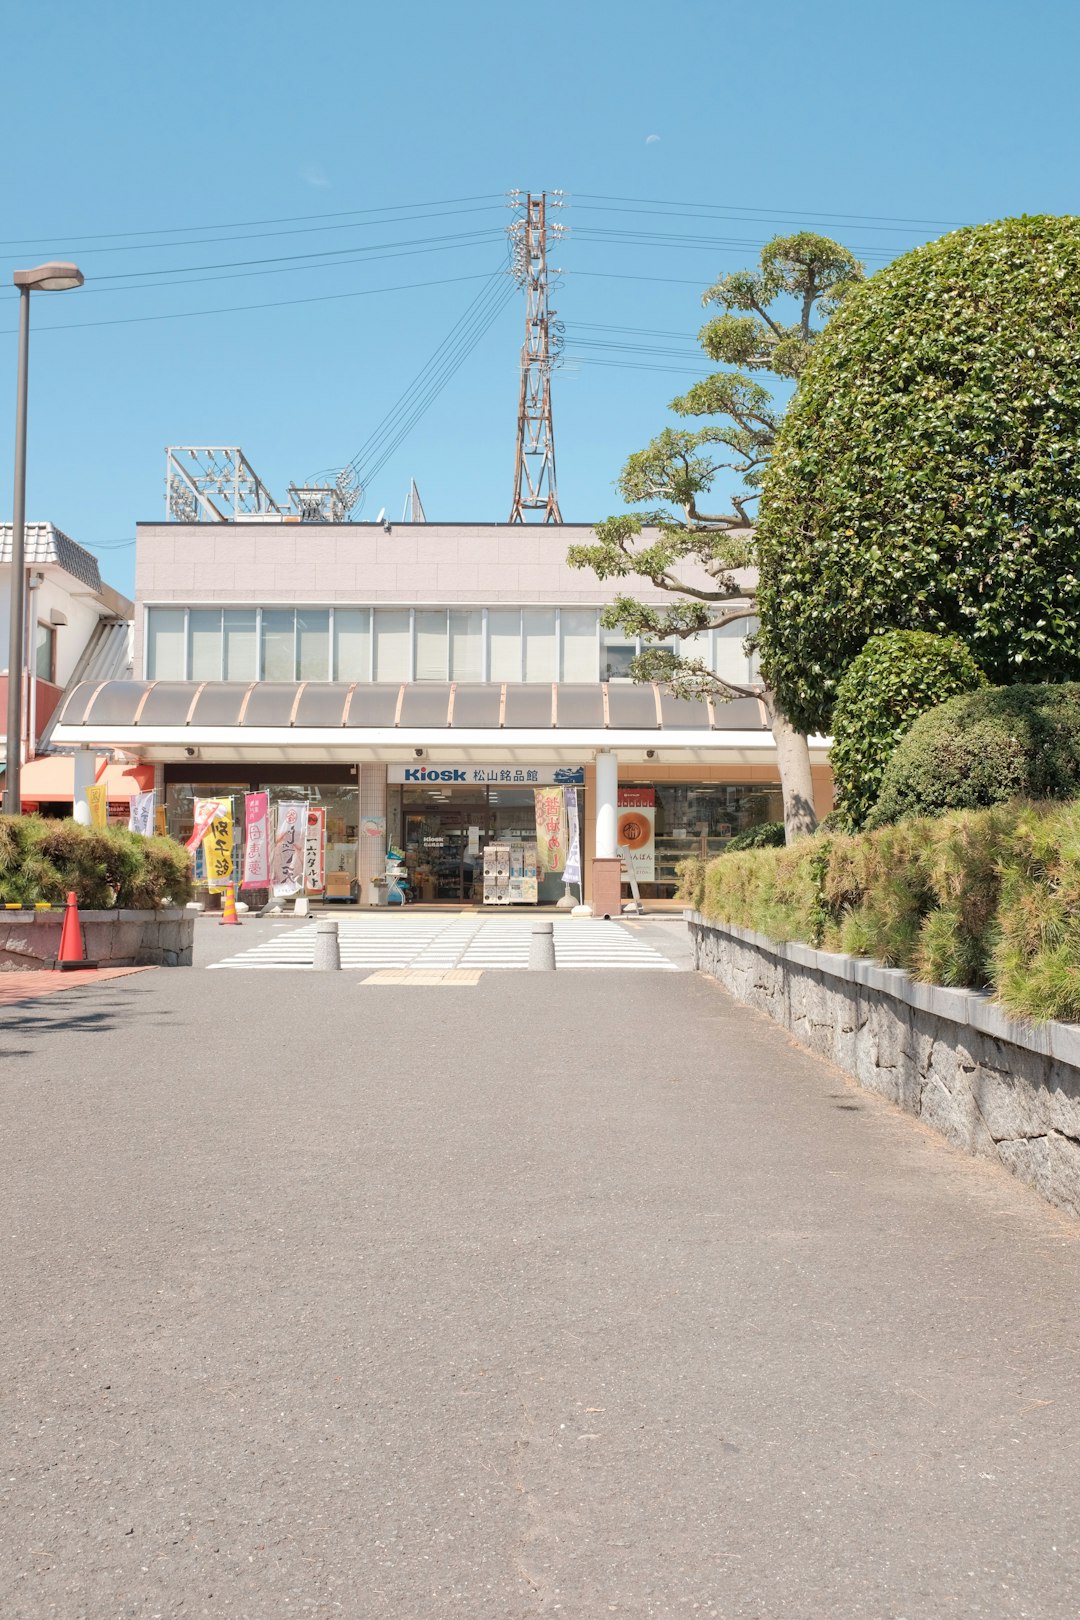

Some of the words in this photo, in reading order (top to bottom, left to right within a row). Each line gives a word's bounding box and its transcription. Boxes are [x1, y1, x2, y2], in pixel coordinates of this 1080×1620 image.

[404, 767, 466, 782] Kiosk
[473, 769, 538, 782] 松山銘品館
[306, 838, 319, 888] 一六タルト
